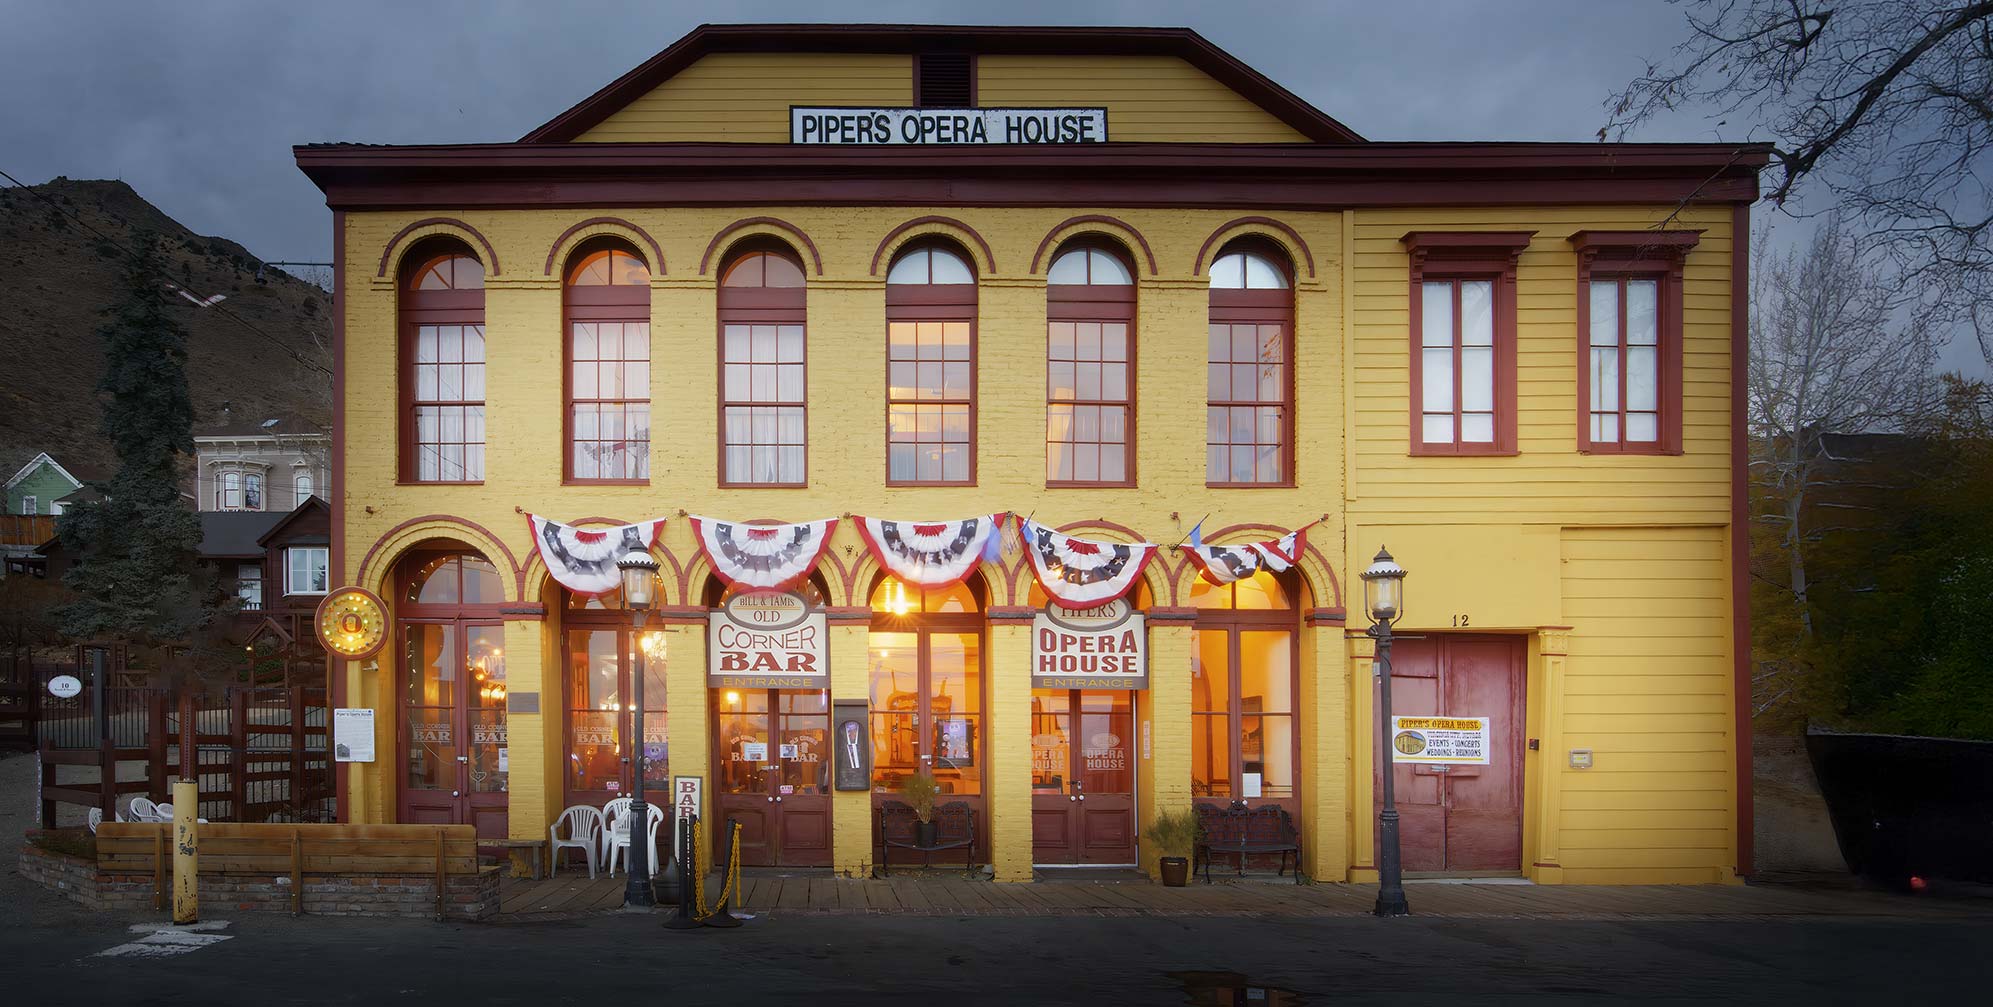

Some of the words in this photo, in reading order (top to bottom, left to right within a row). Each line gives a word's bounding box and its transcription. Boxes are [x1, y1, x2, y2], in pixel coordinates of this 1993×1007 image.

[802, 112, 891, 143] PIPER'S
[901, 115, 988, 143] OPERA
[1005, 116, 1095, 143] HOUSE
[739, 596, 758, 606] BILL
[753, 610, 781, 622] OLD
[1453, 614, 1469, 627] 12
[718, 624, 816, 649] CORNER
[1040, 627, 1138, 653] OPERA
[720, 651, 817, 672] BAR
[1039, 655, 1138, 673] HOUSE
[723, 677, 813, 687] ENTRANCE
[1043, 679, 1133, 688] ENTRANCE
[1432, 720, 1455, 729] OPERA
[1456, 721, 1479, 729] HOUSE
[413, 731, 451, 741] BAR
[576, 733, 614, 744] BAR
[1428, 739, 1450, 747] EVENTS
[1455, 739, 1481, 748] CONCERTS
[1032, 749, 1065, 759] PERA
[1087, 749, 1125, 759] OPERA
[1426, 748, 1452, 757] WEDDINGS
[1455, 749, 1482, 757] REUNIONS
[1087, 759, 1125, 769] HOUSE
[679, 781, 696, 818] BAR
